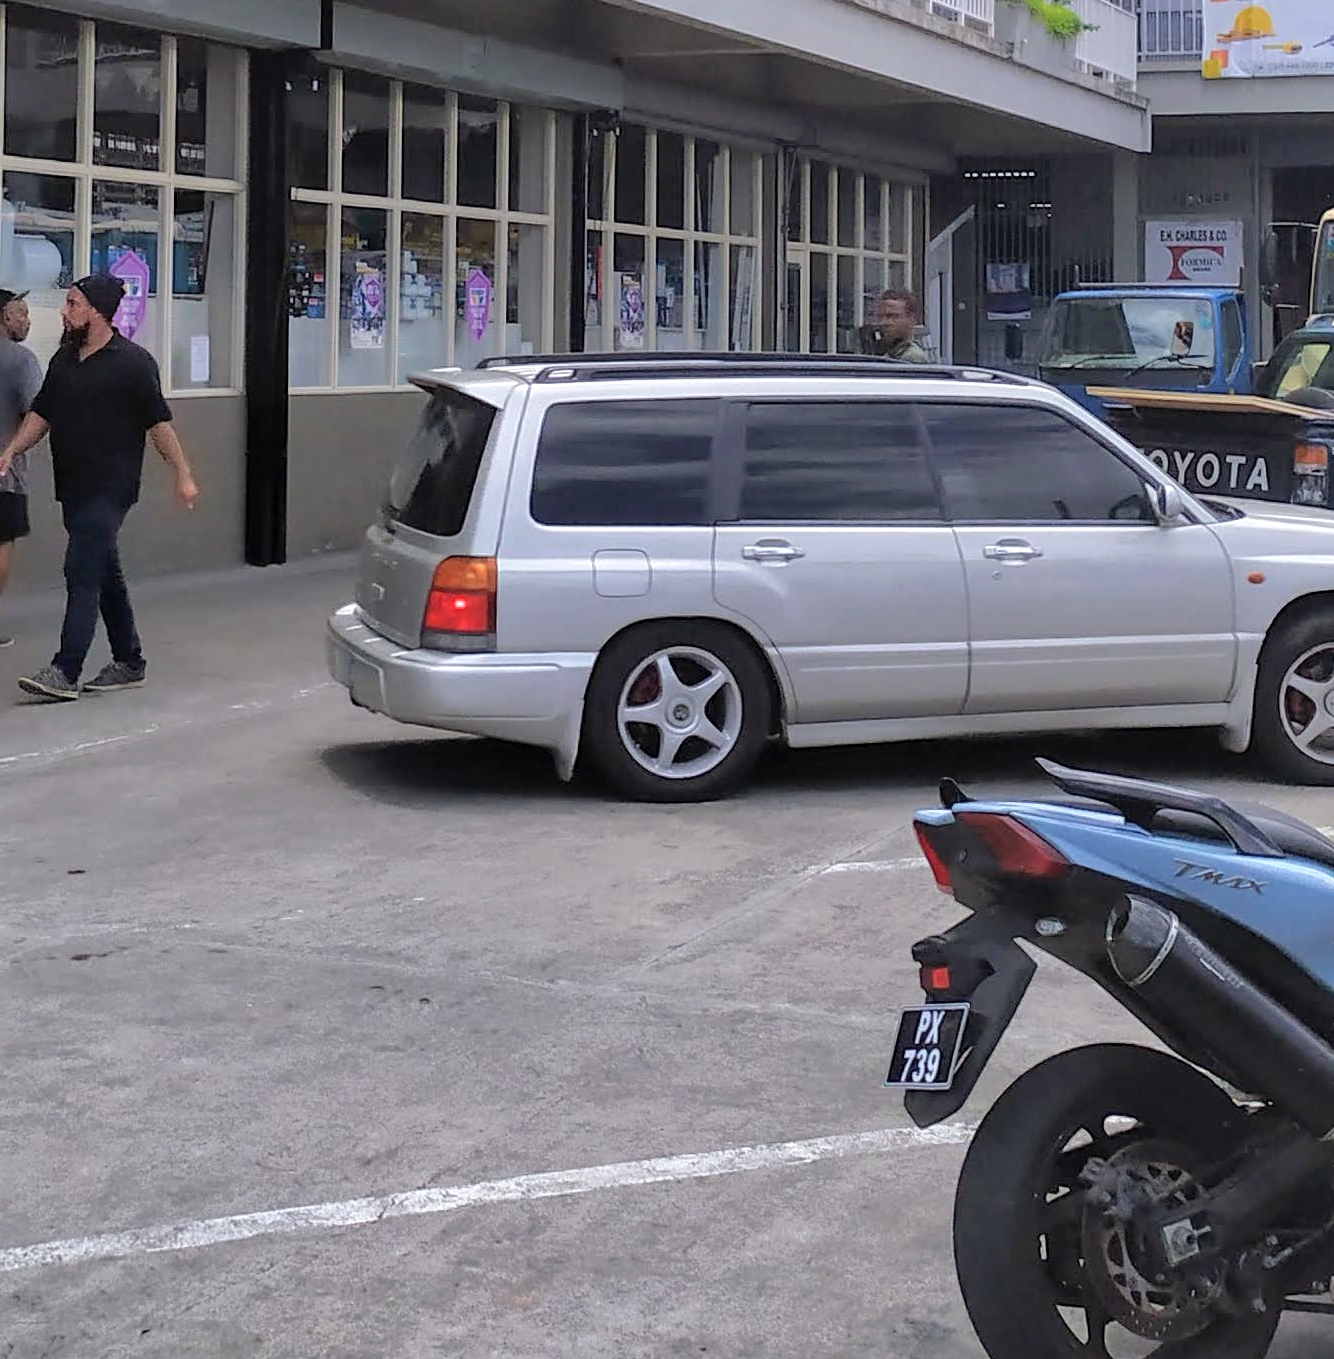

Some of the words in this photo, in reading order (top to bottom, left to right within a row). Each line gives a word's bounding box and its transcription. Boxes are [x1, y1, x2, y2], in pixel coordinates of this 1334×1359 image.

[1175, 230, 1207, 241] CHARLES
[1208, 230, 1215, 241] &
[1180, 258, 1222, 267] FORMICA
[1138, 438, 1269, 491] OYOTA
[915, 1010, 946, 1044] PX
[900, 1047, 940, 1082] 739
